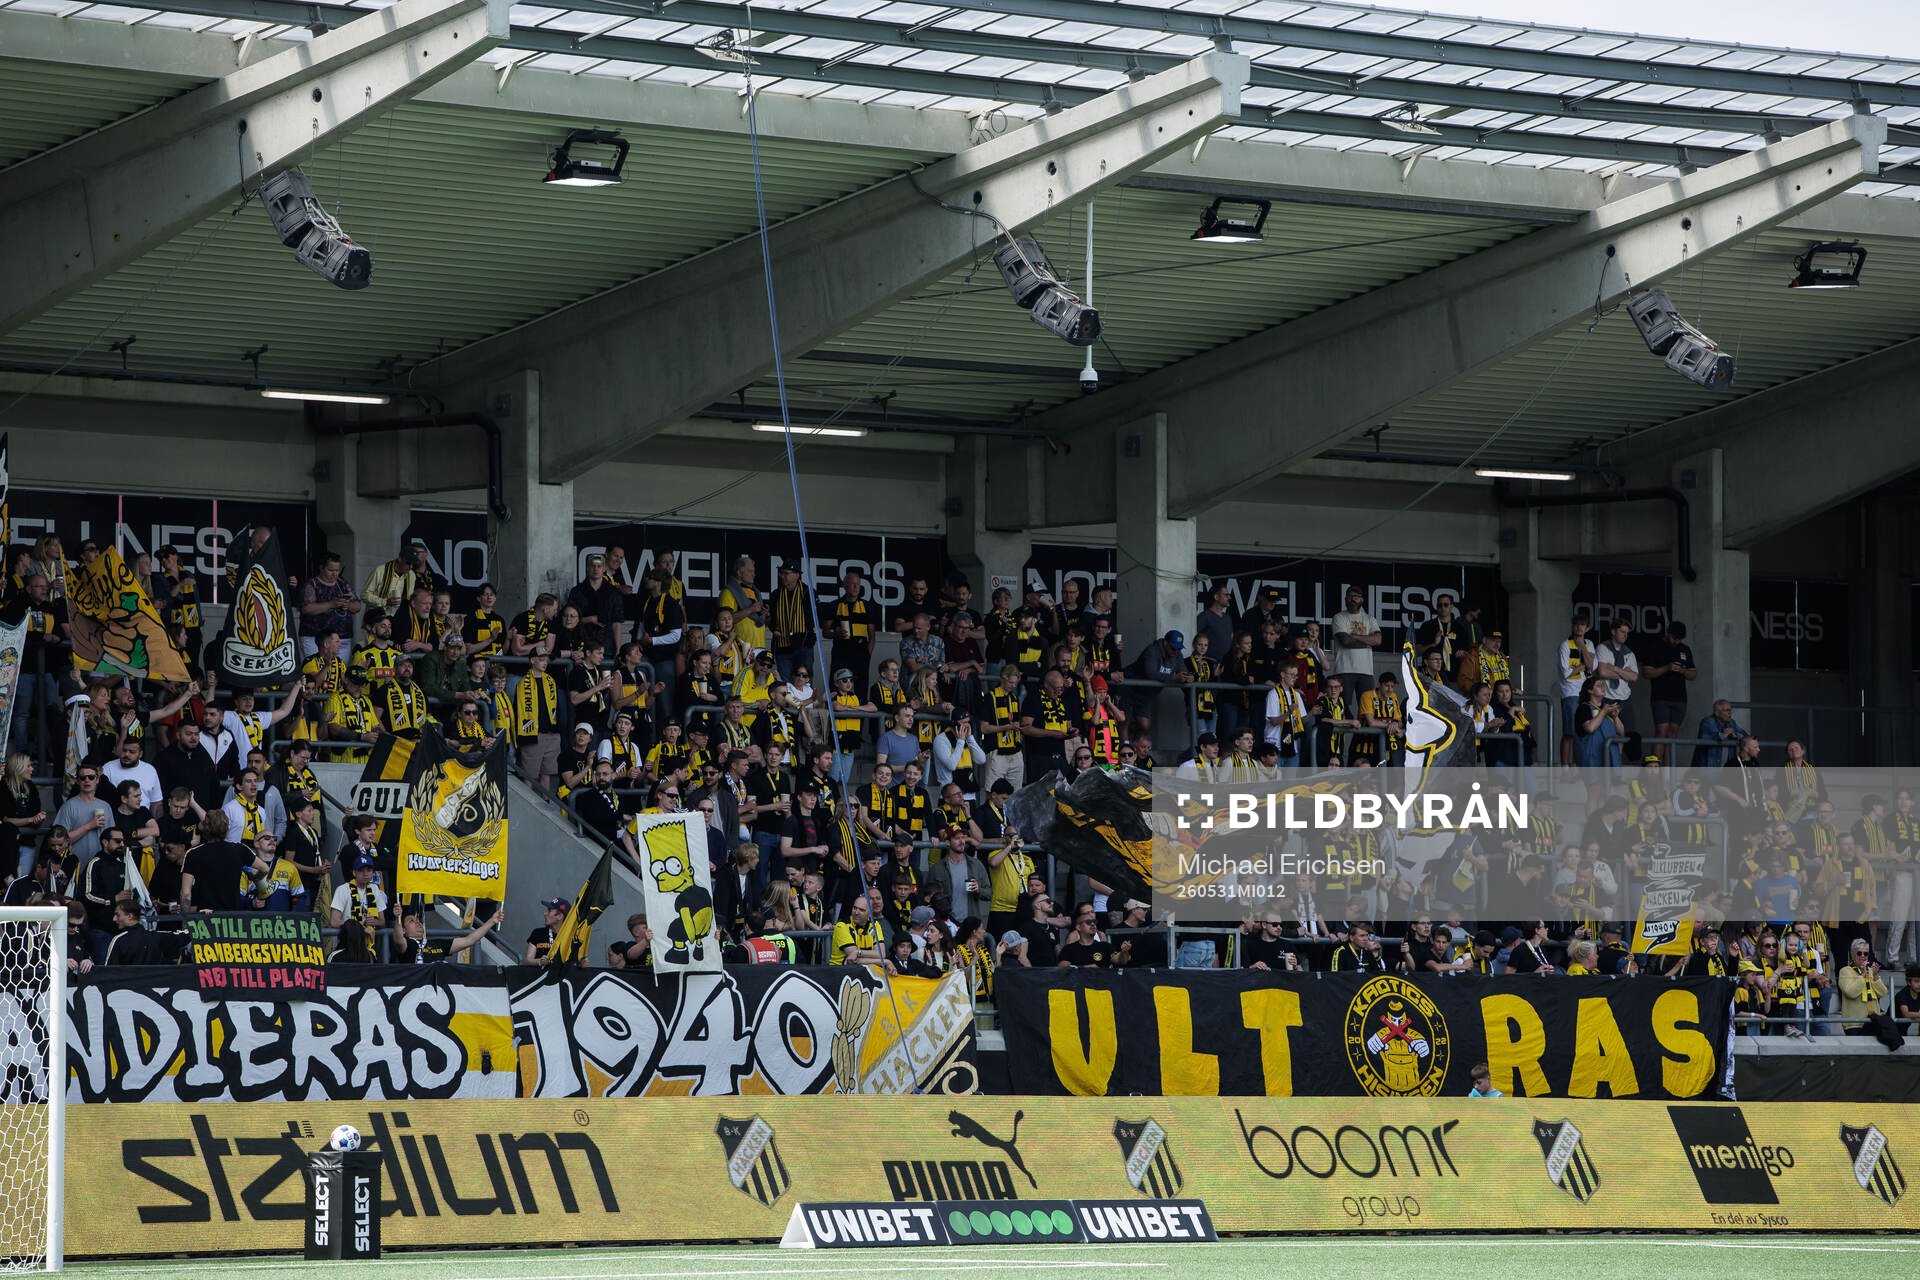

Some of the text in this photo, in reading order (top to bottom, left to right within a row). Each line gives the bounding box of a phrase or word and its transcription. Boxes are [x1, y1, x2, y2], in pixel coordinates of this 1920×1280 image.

[408, 853, 499, 879] Kvarterslaget
[188, 916, 320, 942] JA TILL GRÄS PÅ
[230, 968, 266, 988] TILL
[270, 967, 324, 990] PLAST!
[1353, 979, 1435, 1017] KAOTICS
[512, 973, 841, 1097] 1940
[1234, 1108, 1460, 1179] boomr
[1690, 1136, 1794, 1176] menigo
[882, 1161, 1018, 1200] PUMA
[315, 1175, 330, 1246] SELECT
[355, 1175, 370, 1252] SELECT
[807, 1208, 937, 1244] UNIBET
[1080, 1207, 1206, 1239] UNIBET
[1342, 1196, 1421, 1226] group
[1711, 1212, 1789, 1227] En del av Sysco
